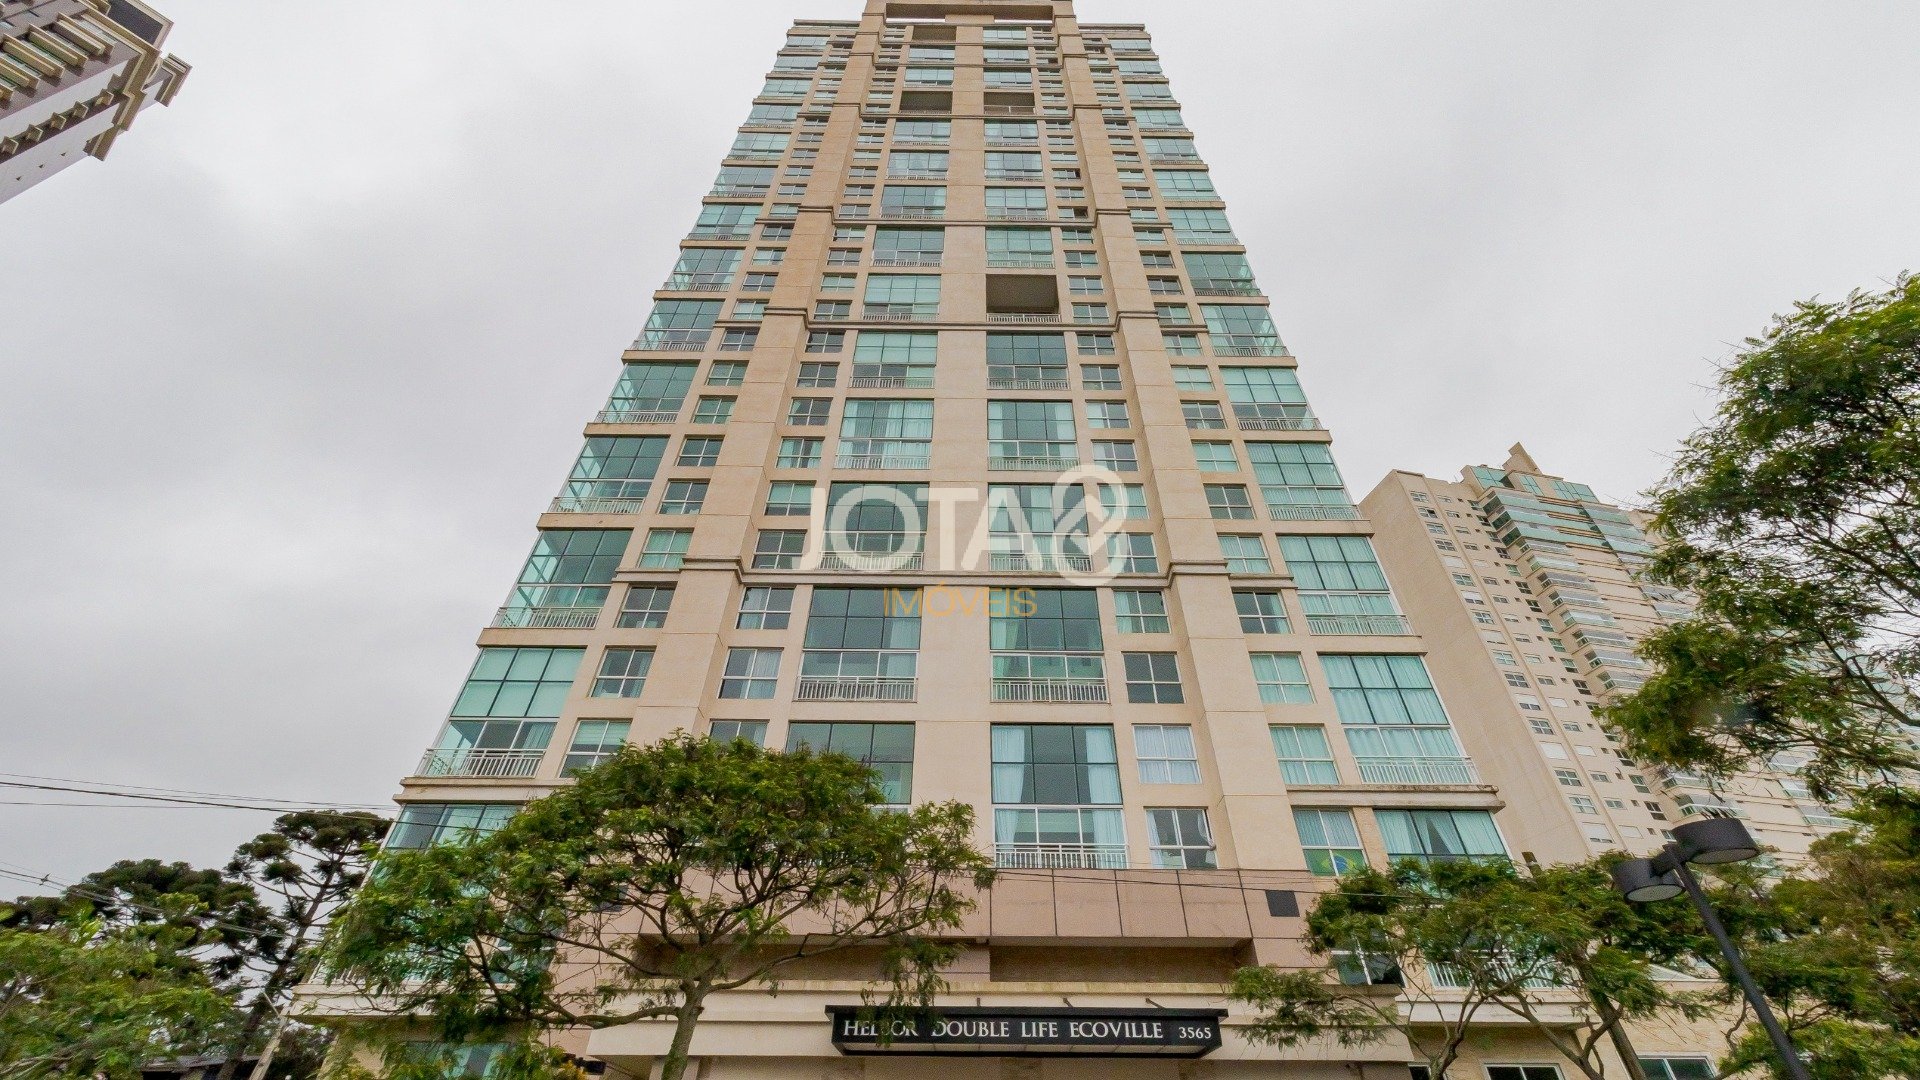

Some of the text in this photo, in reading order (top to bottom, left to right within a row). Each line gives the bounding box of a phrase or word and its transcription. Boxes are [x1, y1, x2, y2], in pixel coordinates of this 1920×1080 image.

[843, 1020, 1212, 1039] HELOR DOUBLE LIFE ECOVILLE 3565
